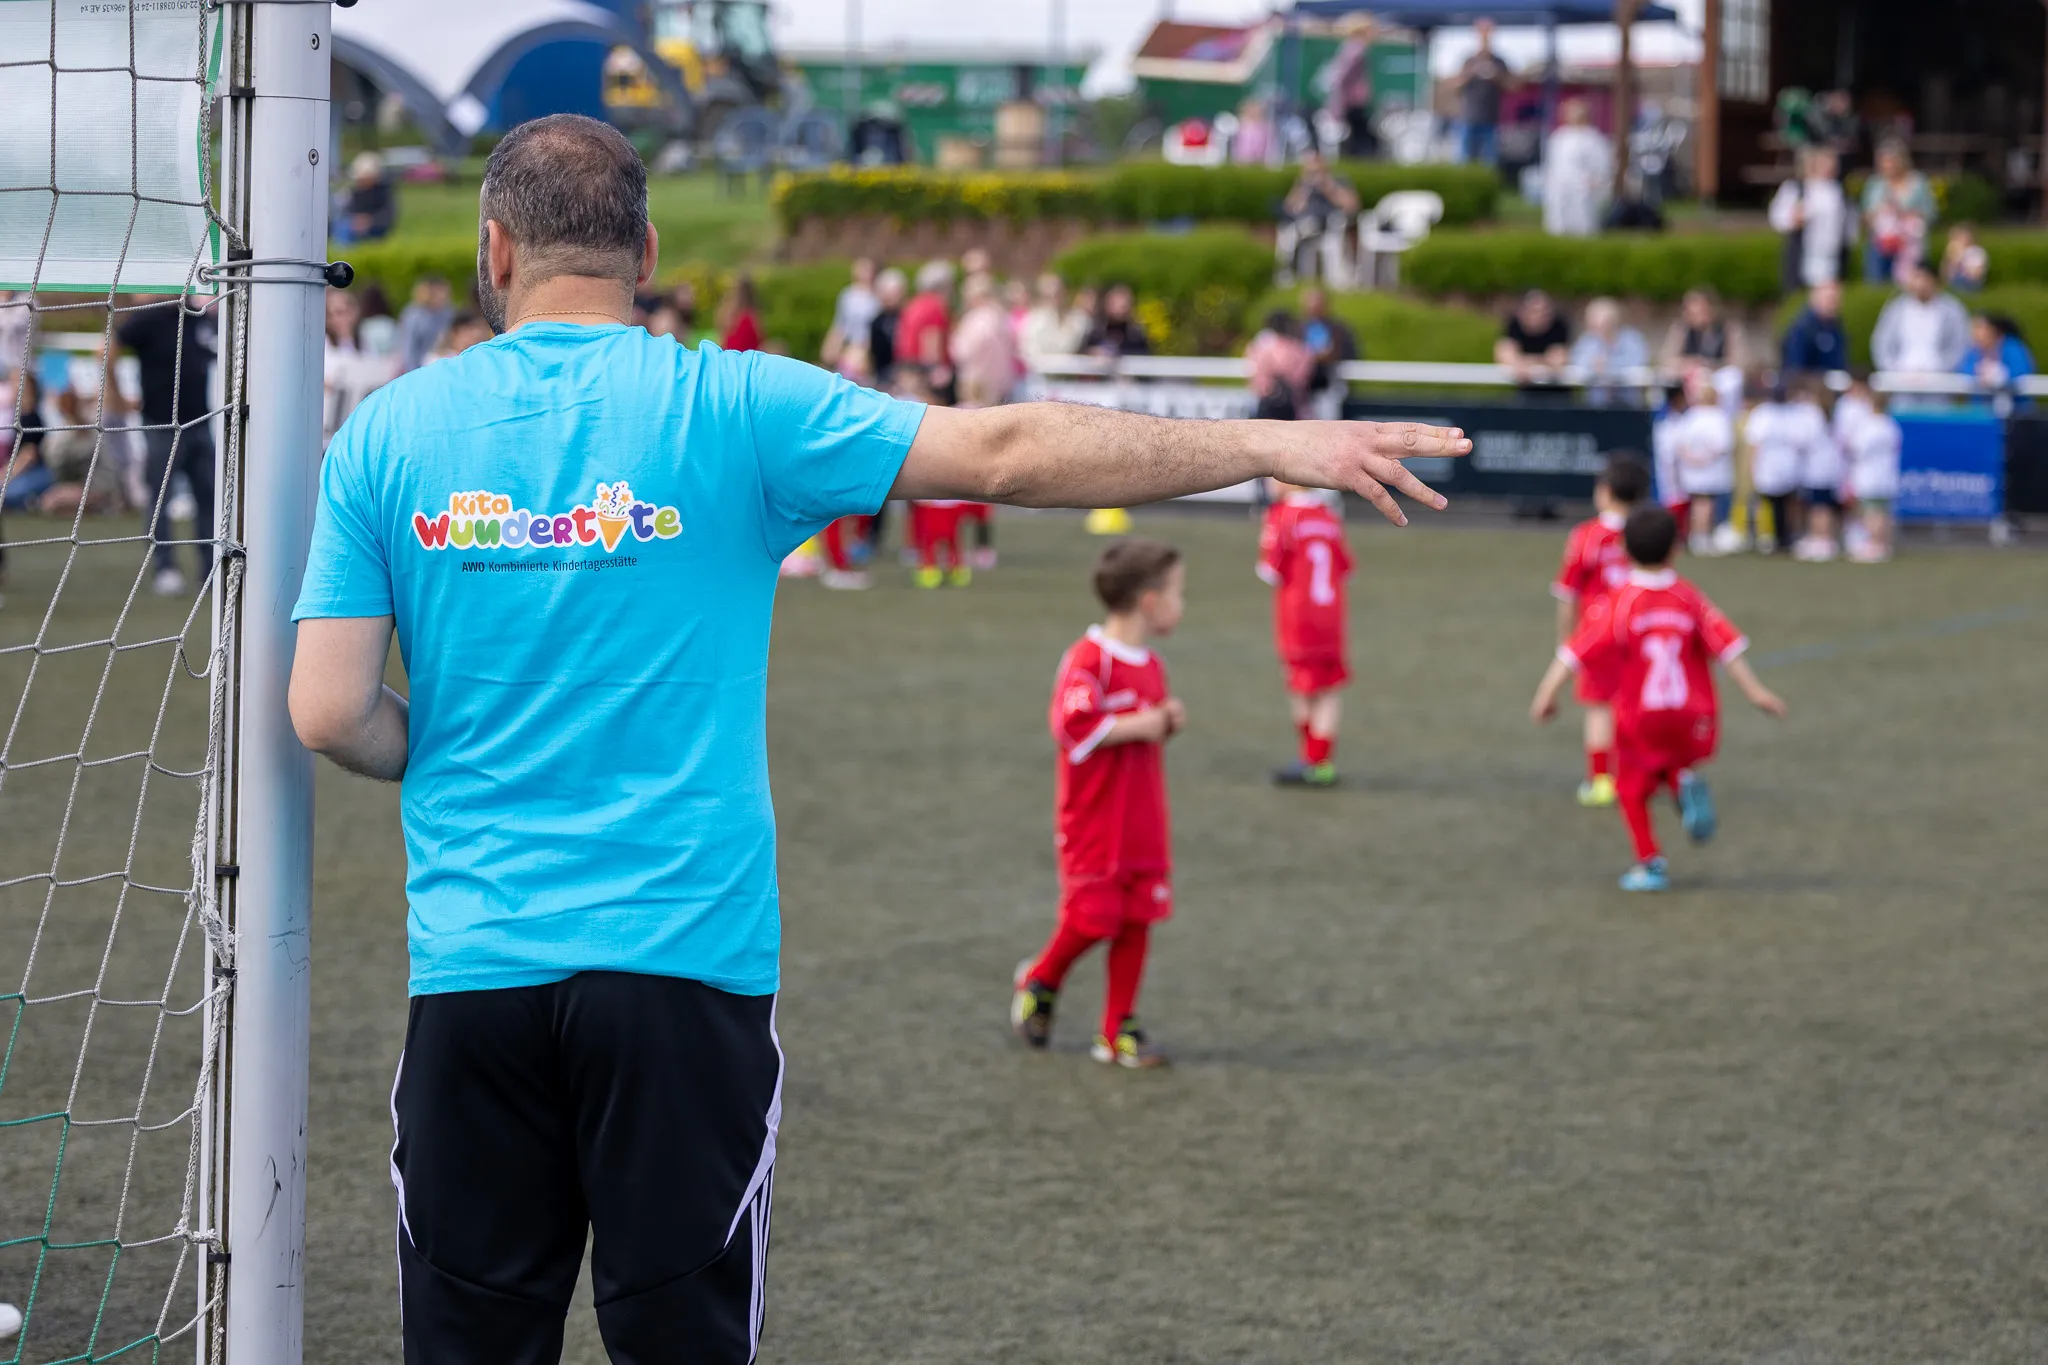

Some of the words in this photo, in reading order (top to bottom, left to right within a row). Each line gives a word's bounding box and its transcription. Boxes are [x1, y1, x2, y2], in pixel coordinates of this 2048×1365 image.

[452, 493, 510, 516] Kita
[461, 560, 486, 573] AWO
[488, 559, 550, 573] Kombinierte
[552, 555, 638, 572] Kindertagesstätte
